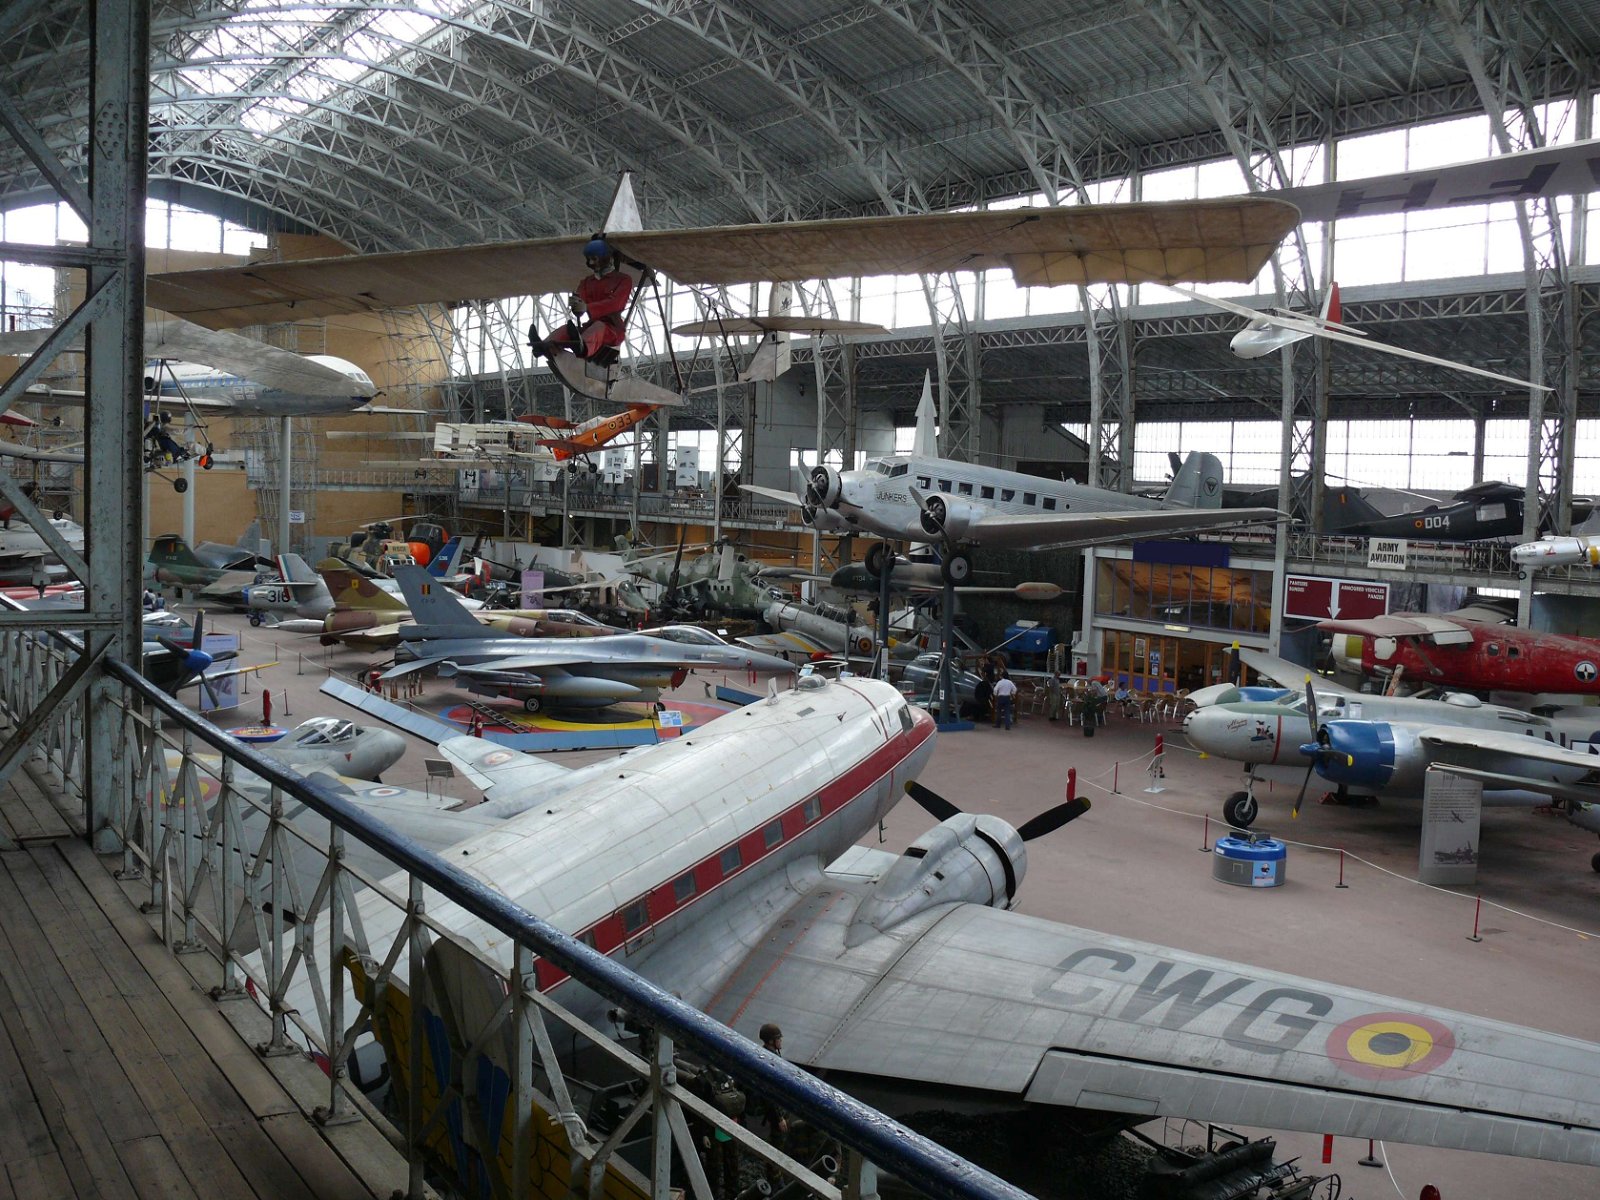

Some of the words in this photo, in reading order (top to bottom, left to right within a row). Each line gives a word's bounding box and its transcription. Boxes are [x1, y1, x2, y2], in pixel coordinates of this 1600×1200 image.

[617, 413, 631, 428] 33
[876, 491, 907, 502] JUNKERS
[1377, 542, 1399, 552] ARMY
[1370, 553, 1405, 564] AVIATION
[267, 589, 291, 603] 316
[1031, 948, 1334, 1055] CWG
